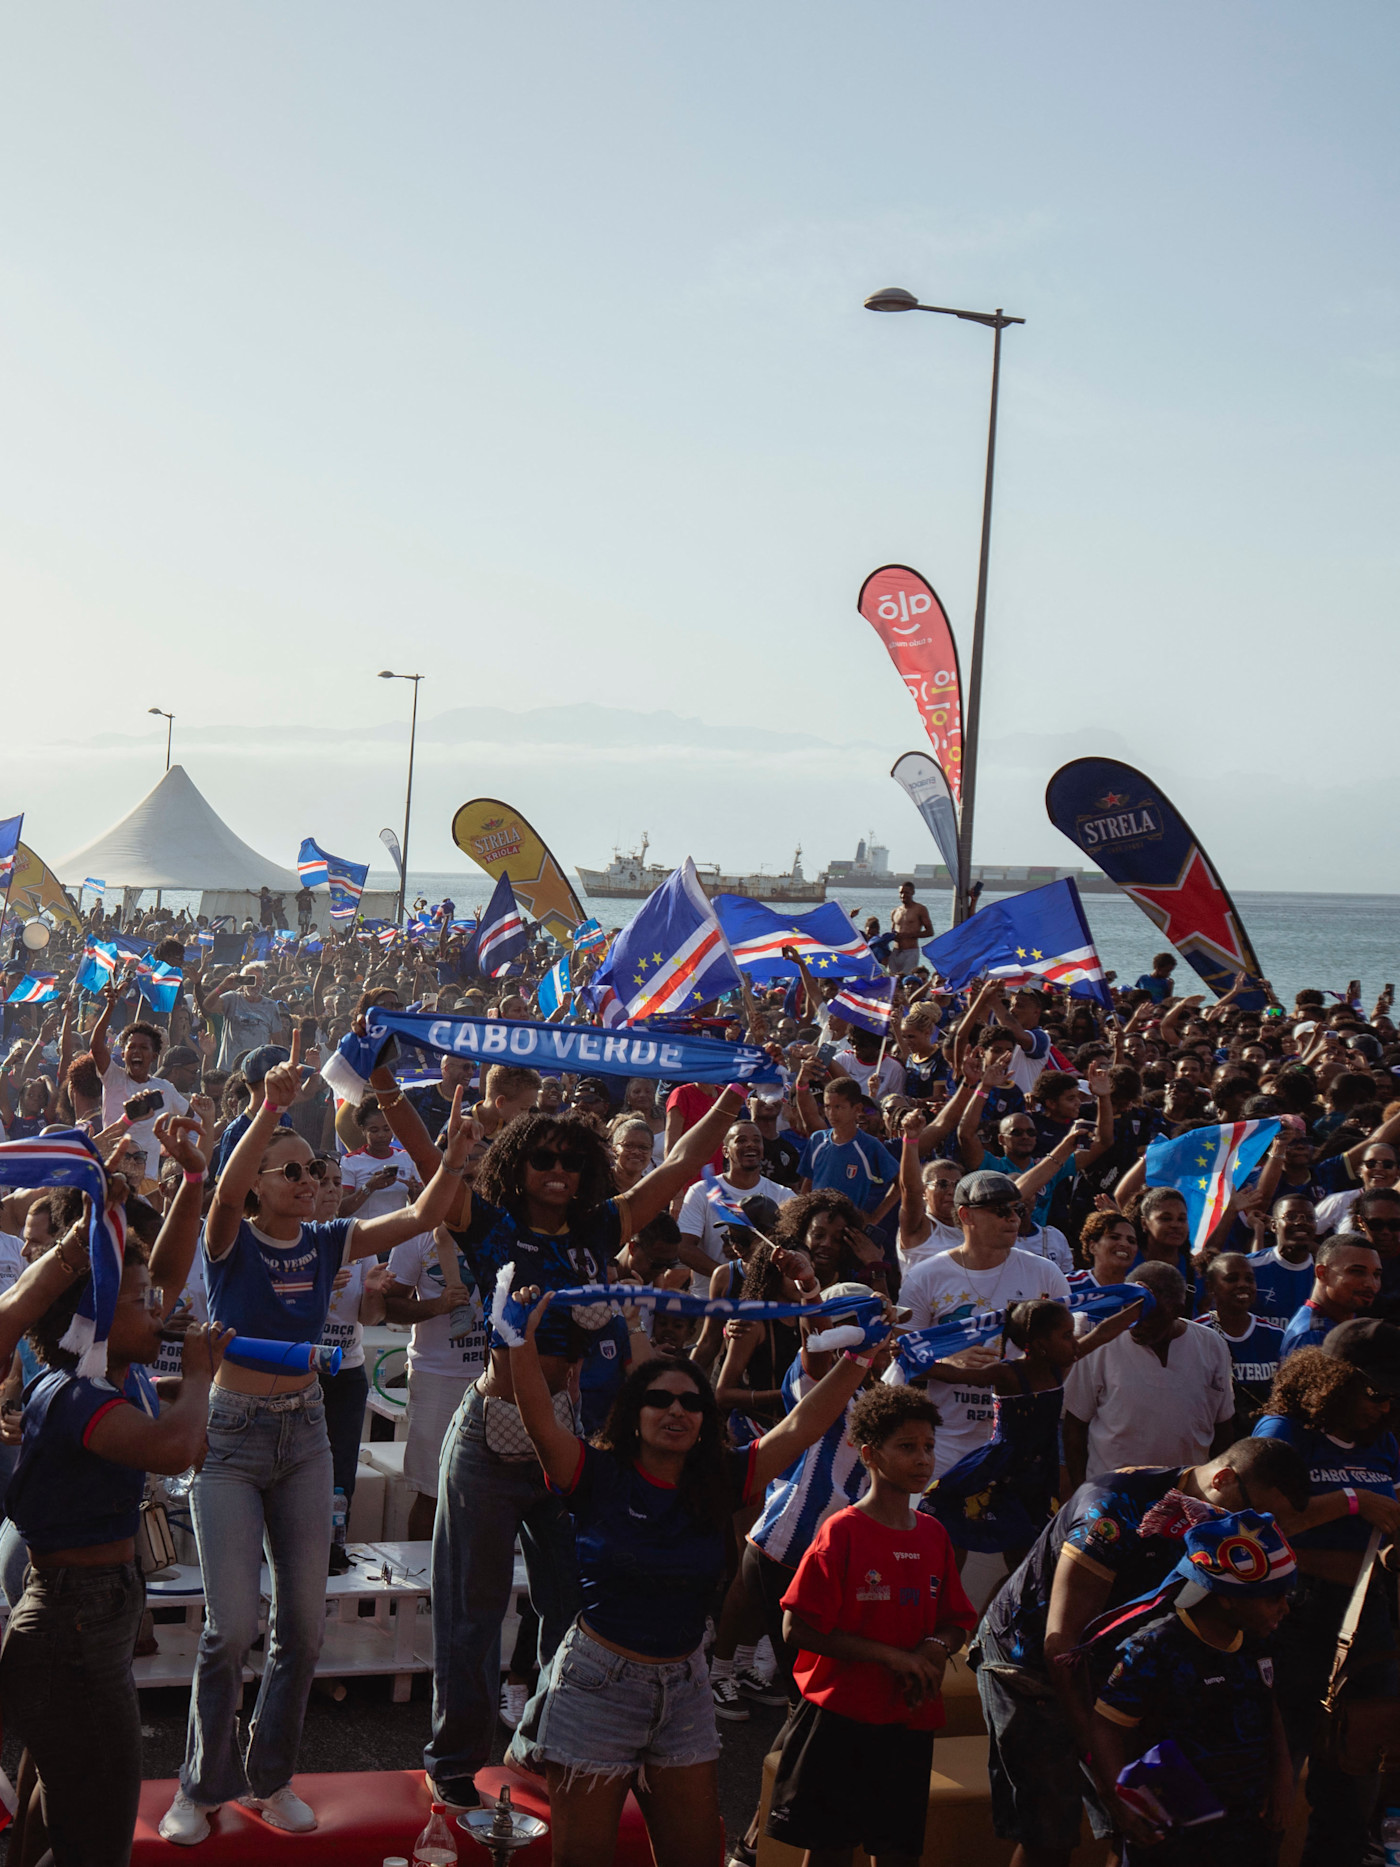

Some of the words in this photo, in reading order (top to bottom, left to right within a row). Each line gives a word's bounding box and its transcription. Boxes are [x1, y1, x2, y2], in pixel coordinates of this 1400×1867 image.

[1084, 810, 1157, 844] STRELA
[474, 827, 521, 854] STRELA
[486, 846, 518, 862] KRIOLA
[428, 1020, 538, 1056] CABO
[552, 1030, 684, 1069] VERDE
[517, 1240, 539, 1252] tempo
[323, 1323, 354, 1336] ORÇA
[449, 1336, 485, 1348] TUBA
[1234, 1362, 1279, 1381] VERDE
[953, 1391, 991, 1405] TUBA
[1309, 1468, 1350, 1483] CABO
[1204, 1676, 1226, 1686] tempo
